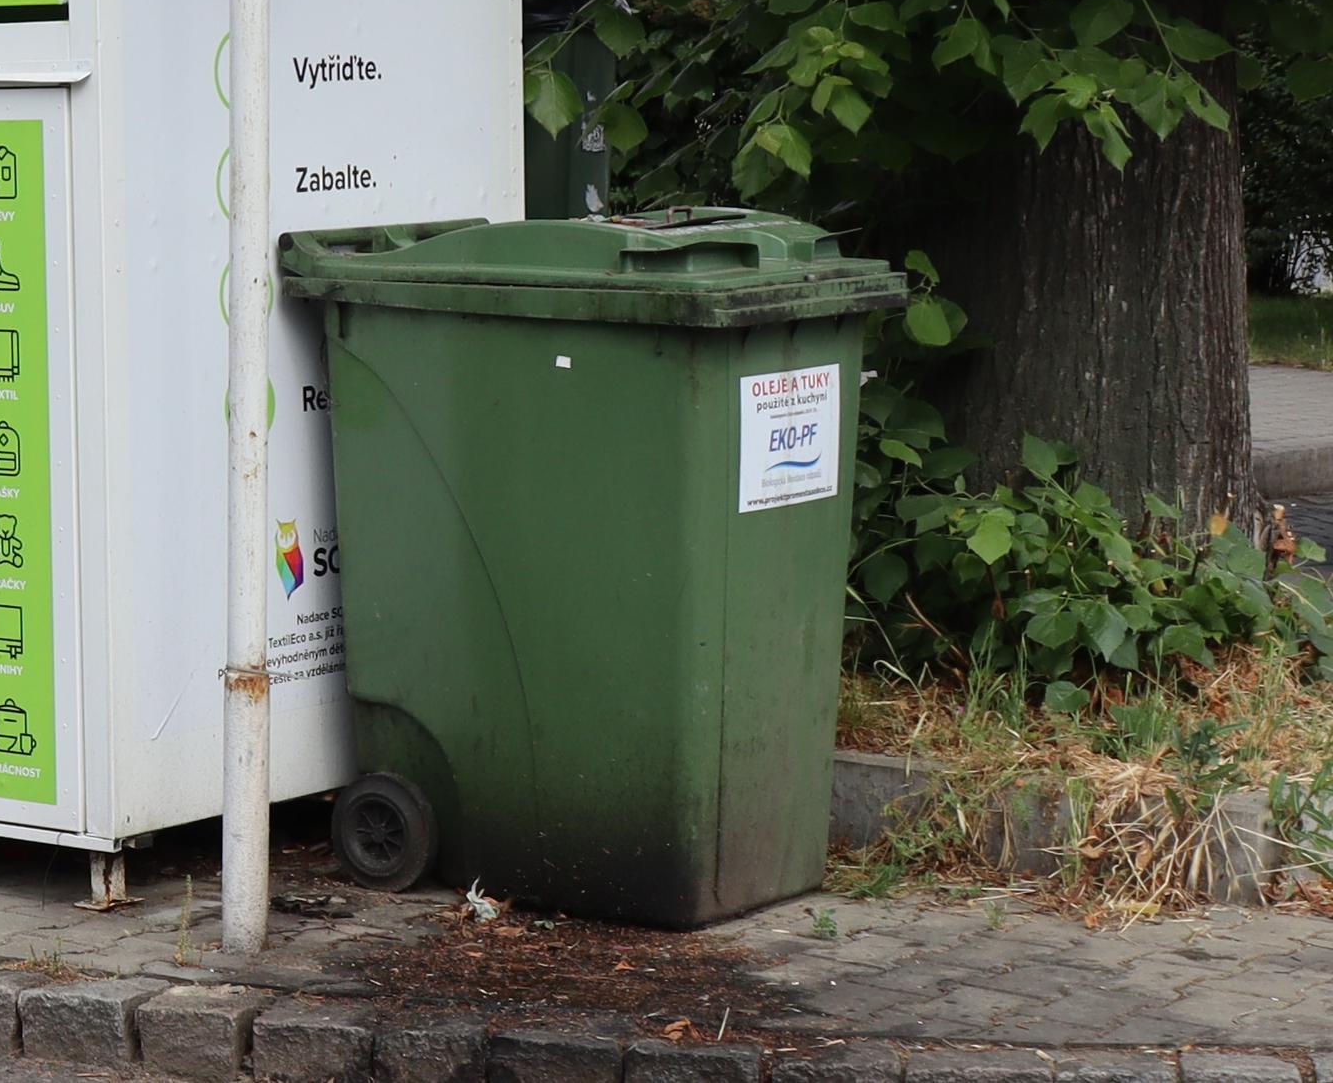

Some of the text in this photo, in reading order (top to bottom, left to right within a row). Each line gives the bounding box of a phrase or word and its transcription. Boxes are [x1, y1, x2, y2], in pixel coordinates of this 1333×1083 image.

[293, 54, 382, 90] Vytřiďte.
[296, 164, 377, 193] Zabalte.
[752, 372, 830, 397] OLEJE A TUKY
[756, 396, 789, 413] použité
[790, 397, 795, 406] z
[769, 423, 818, 452] EKO-PF
[296, 611, 330, 625] Nadace
[268, 633, 306, 649] TextilEco
[266, 648, 328, 669] evýhodněným
